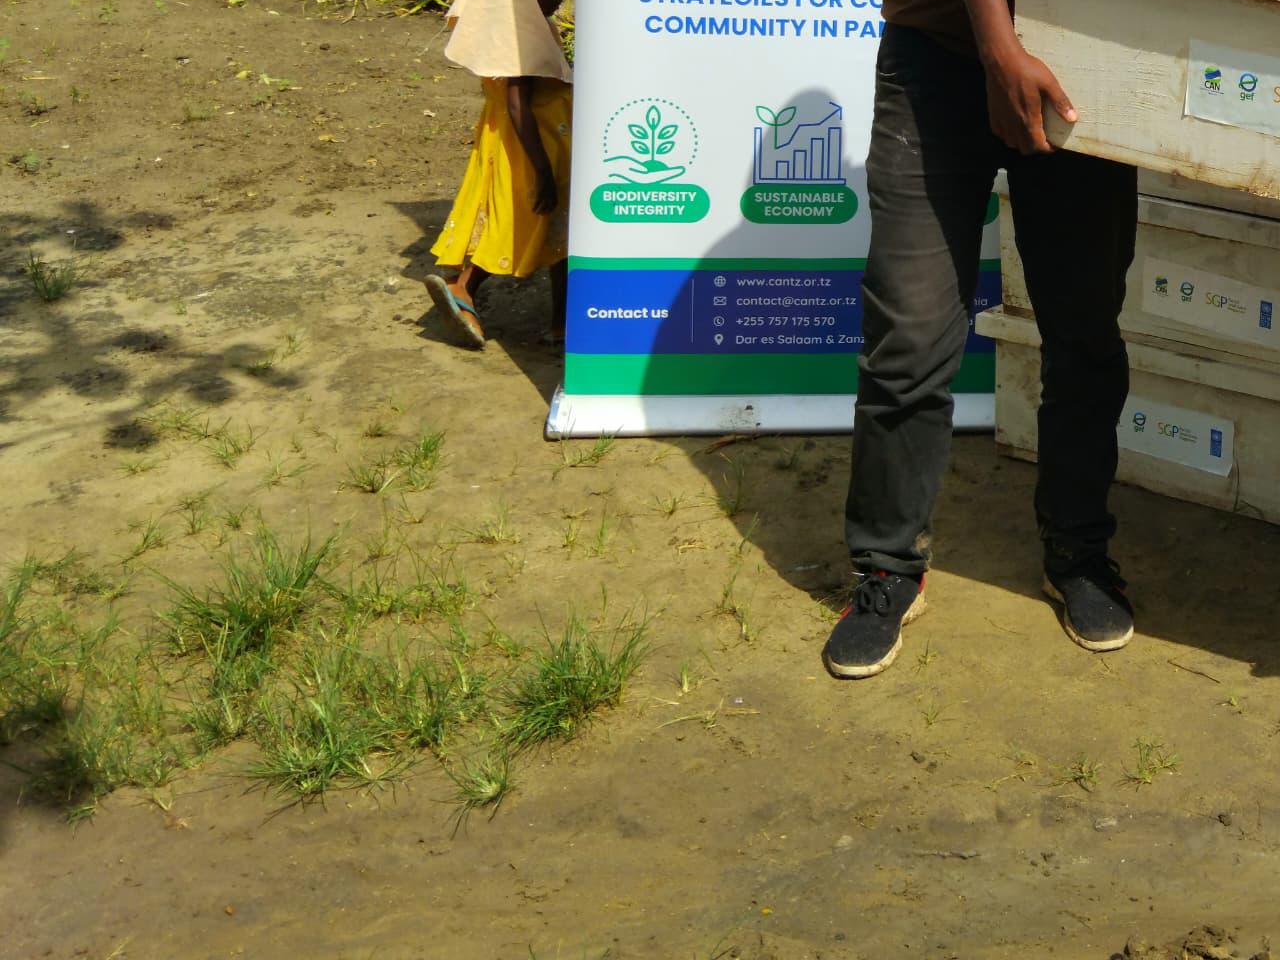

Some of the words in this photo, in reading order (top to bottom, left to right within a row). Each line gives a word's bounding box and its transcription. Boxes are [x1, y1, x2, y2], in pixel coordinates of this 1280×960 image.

[644, 15, 807, 38] COMMUNITY
[813, 19, 838, 38] IN
[1204, 80, 1221, 91] CAN
[1239, 92, 1255, 102] gef
[602, 190, 697, 203] BIODIVERSITY
[754, 191, 845, 203] SUSTAINABLE
[614, 204, 686, 216] INTEGRITY
[764, 205, 834, 217] ECONOMY
[736, 276, 832, 288] www.cantz.or.tz
[736, 295, 857, 307] contact@cantz.or.tz
[1205, 291, 1228, 308] SGP
[587, 306, 649, 319] Contact
[651, 308, 669, 319] us
[736, 316, 765, 327] +255
[768, 316, 789, 327] 757
[791, 316, 811, 327] 175
[813, 316, 836, 327] 570
[735, 335, 756, 345] Dar
[760, 336, 775, 345] es
[777, 334, 823, 345] Salaam
[825, 334, 836, 344] &
[1157, 421, 1180, 438] SGP
